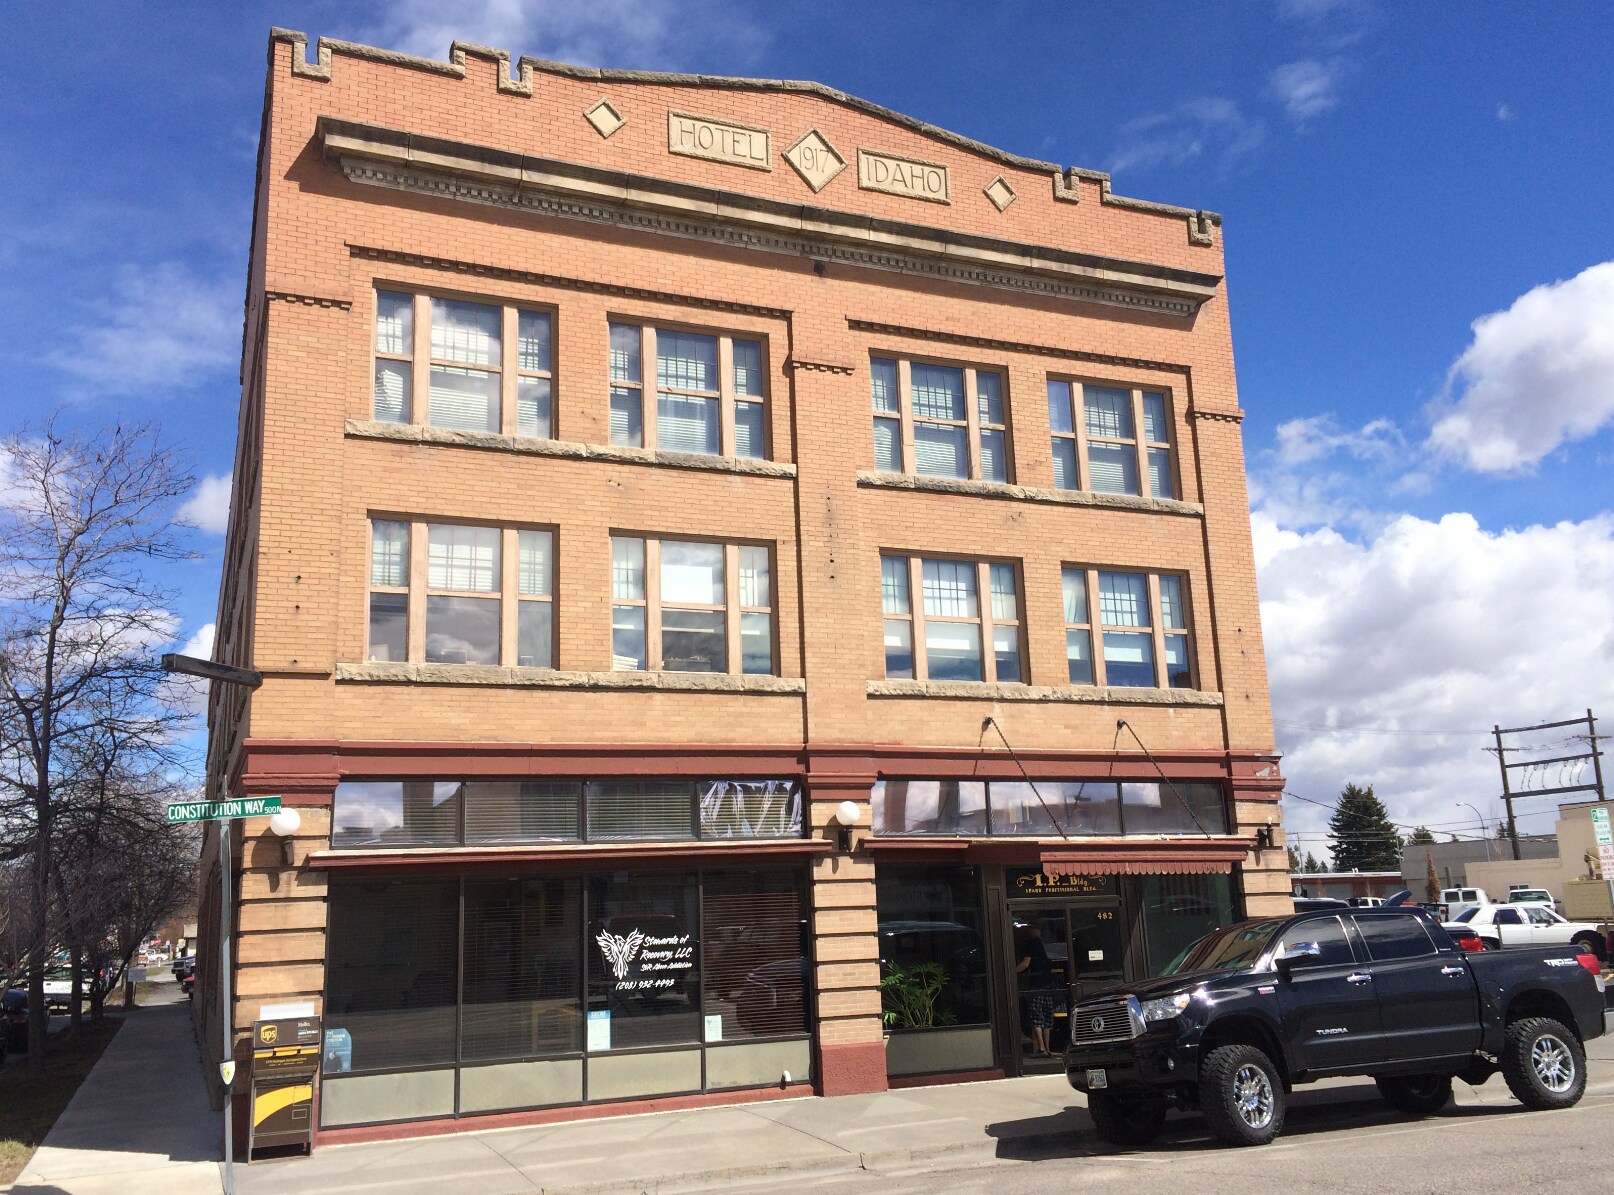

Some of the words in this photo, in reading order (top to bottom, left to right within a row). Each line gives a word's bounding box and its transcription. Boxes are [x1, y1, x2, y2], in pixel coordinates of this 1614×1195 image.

[679, 120, 765, 162] HOTEL
[798, 144, 831, 174] 1917
[865, 156, 943, 194] IDAHO
[168, 802, 241, 819] CONSTITUTION
[244, 799, 265, 814] WAY
[1097, 912, 1113, 920] 482
[643, 934, 678, 947] Stewards
[680, 934, 690, 944] of
[640, 950, 673, 961] Recovery,
[674, 947, 693, 958] LLC
[1543, 959, 1564, 967] TRD
[616, 981, 637, 990] (208)
[262, 1031, 276, 1041] ups
[1315, 1027, 1349, 1036] TUNDRA
